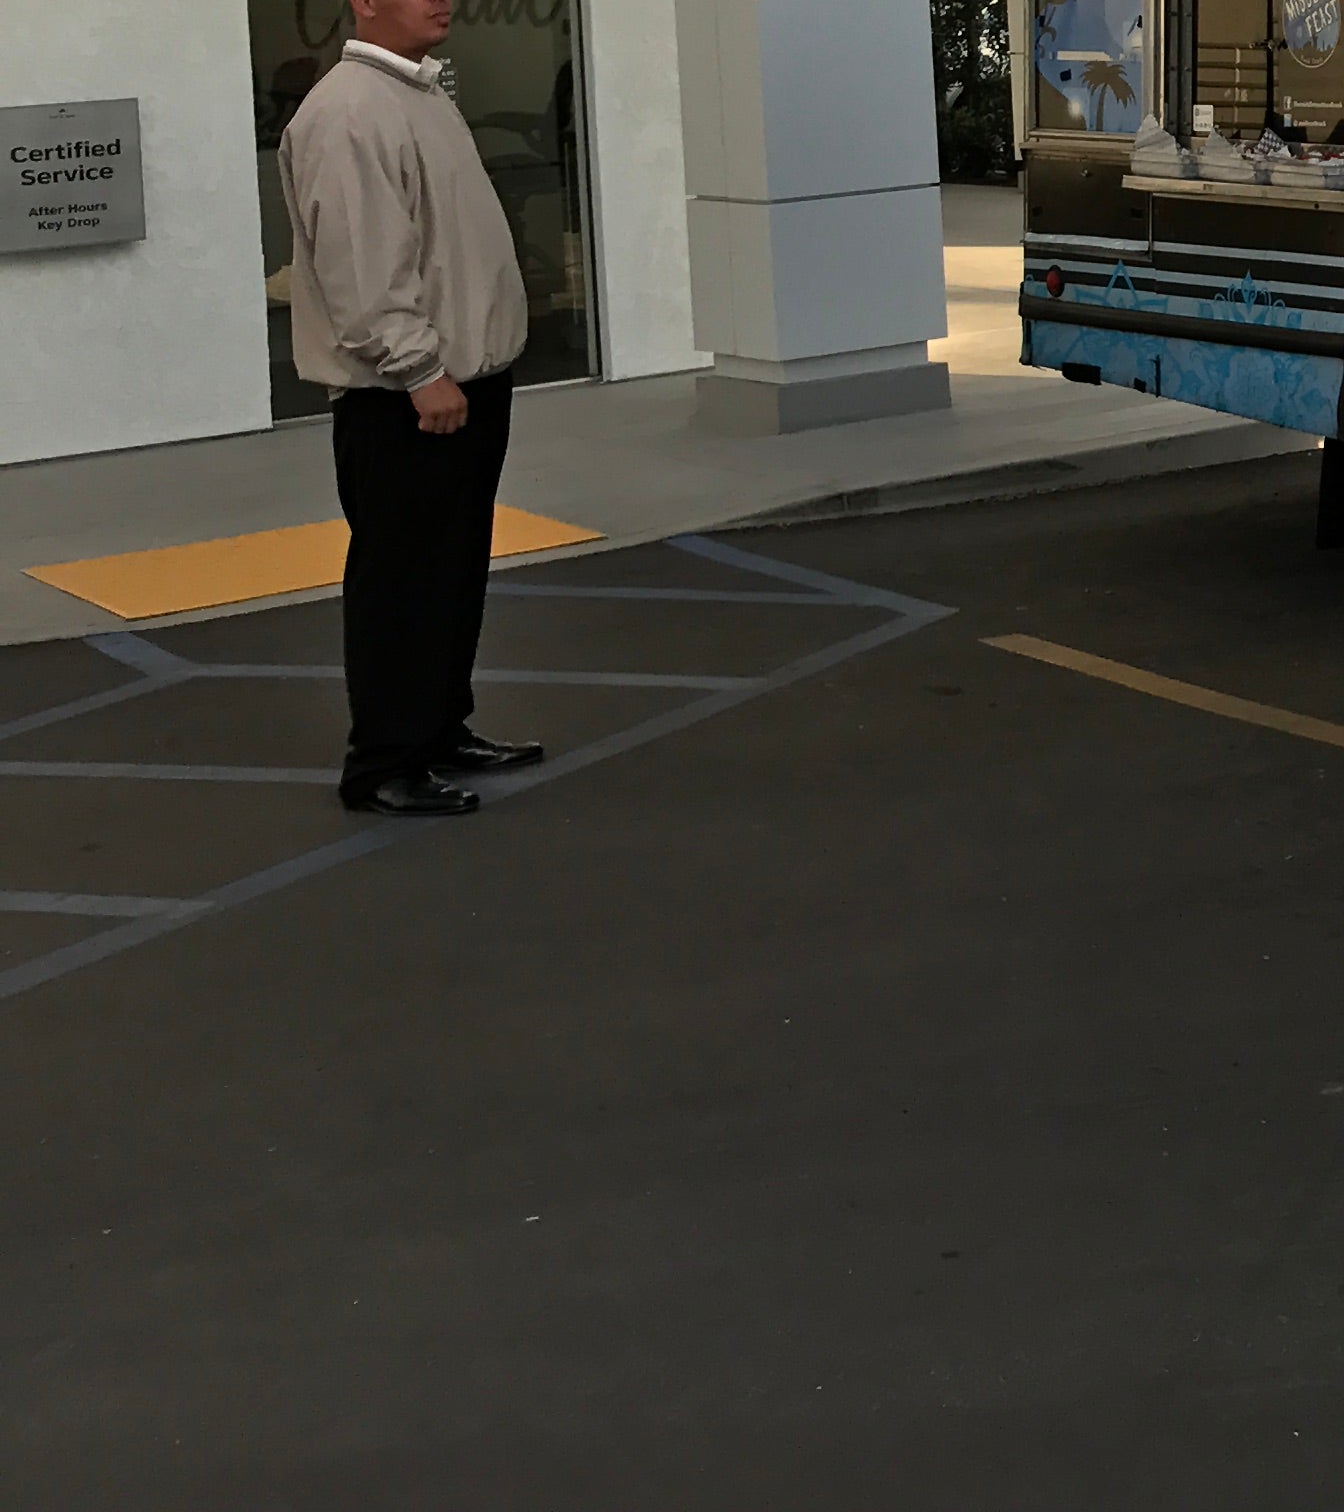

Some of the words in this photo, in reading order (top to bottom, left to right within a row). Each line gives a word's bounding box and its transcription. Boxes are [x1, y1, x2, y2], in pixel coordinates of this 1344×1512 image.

[10, 138, 121, 164] Certified
[20, 164, 114, 186] Service
[28, 205, 65, 218] After
[68, 201, 108, 215] Hours
[37, 220, 63, 232] Key
[67, 216, 100, 229] Drop
